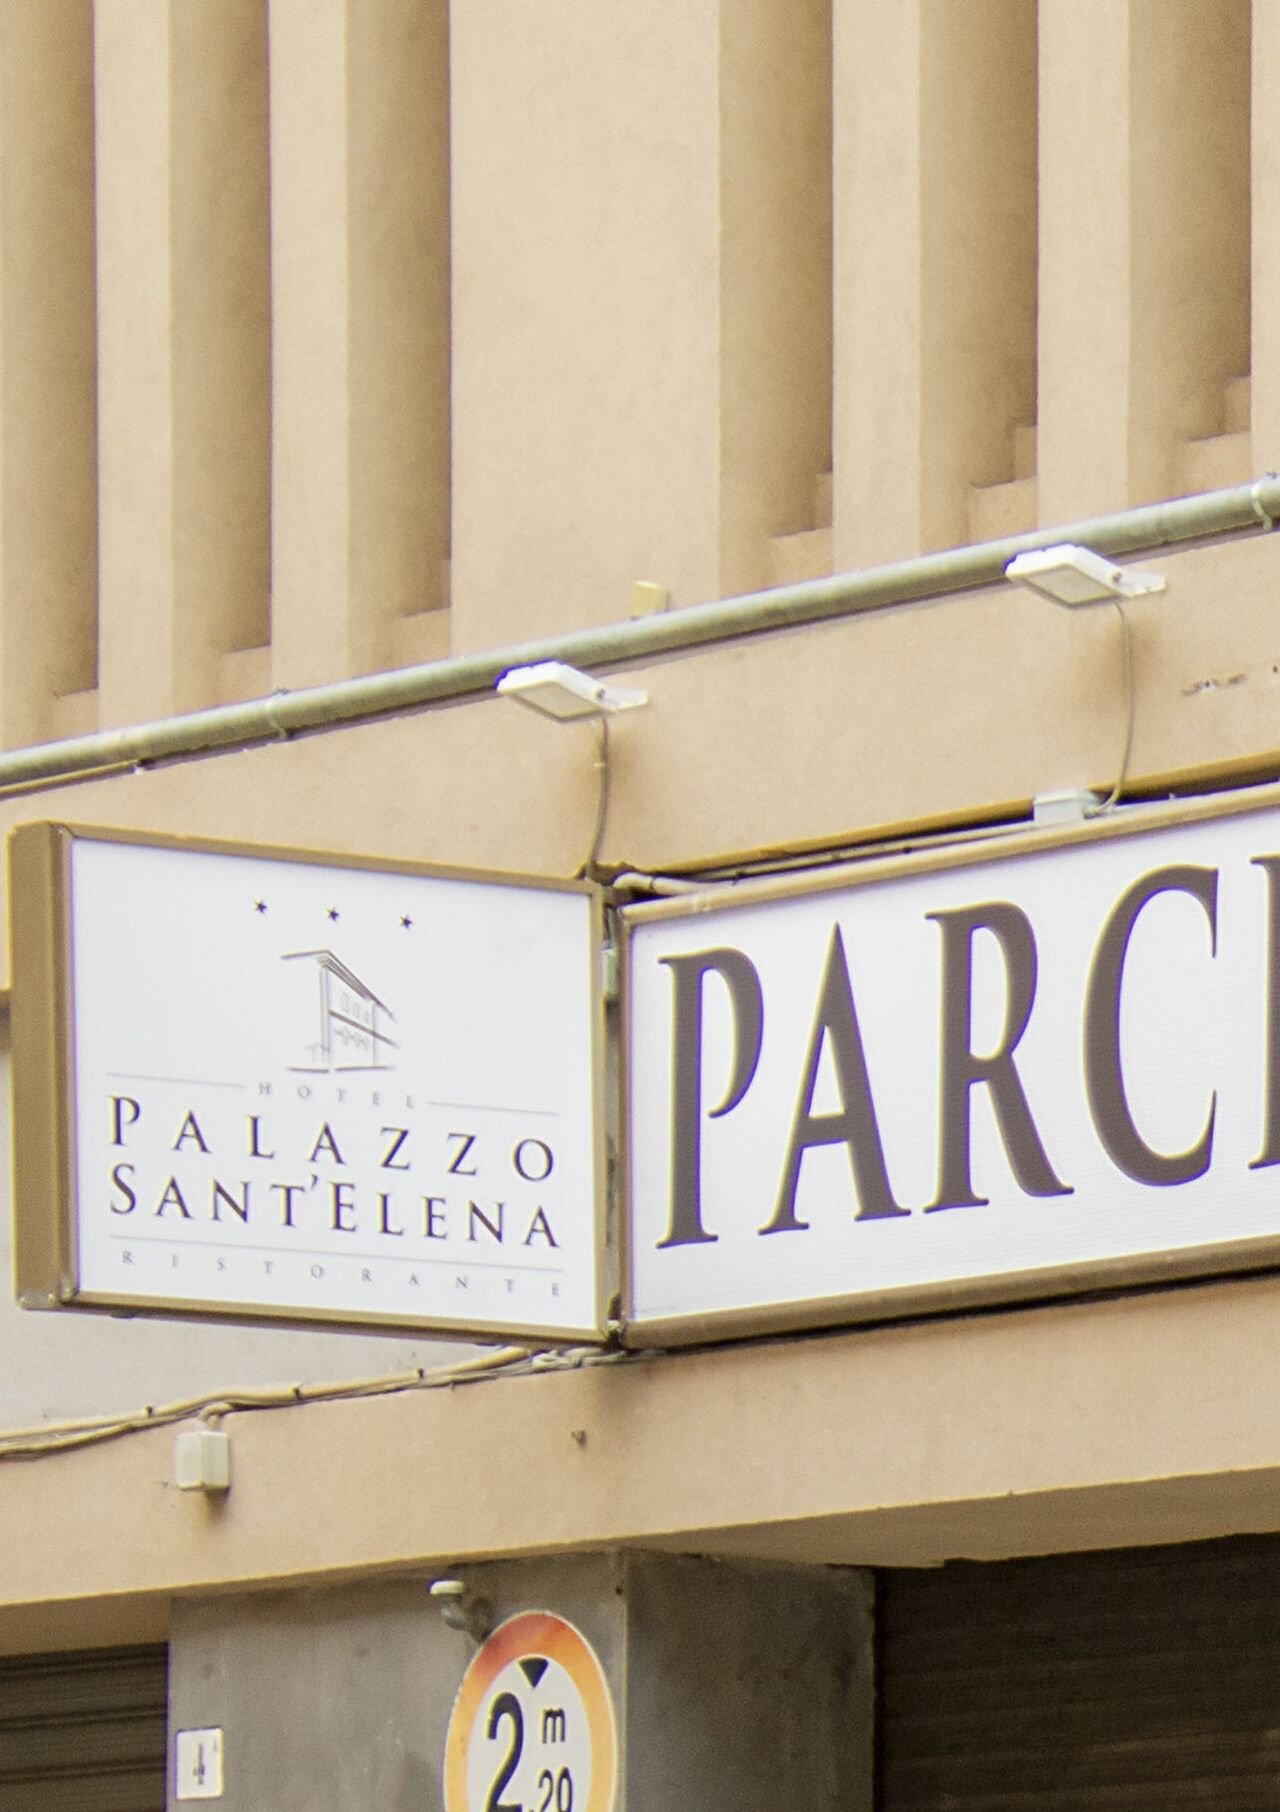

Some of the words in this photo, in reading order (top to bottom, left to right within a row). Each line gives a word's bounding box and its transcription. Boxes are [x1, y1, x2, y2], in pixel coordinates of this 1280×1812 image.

[258, 1081, 415, 1109] HOTEL
[107, 1094, 555, 1183] PALAZZO
[109, 1162, 561, 1249] SANT'ELENA
[121, 1250, 561, 1297] RISTORANTE
